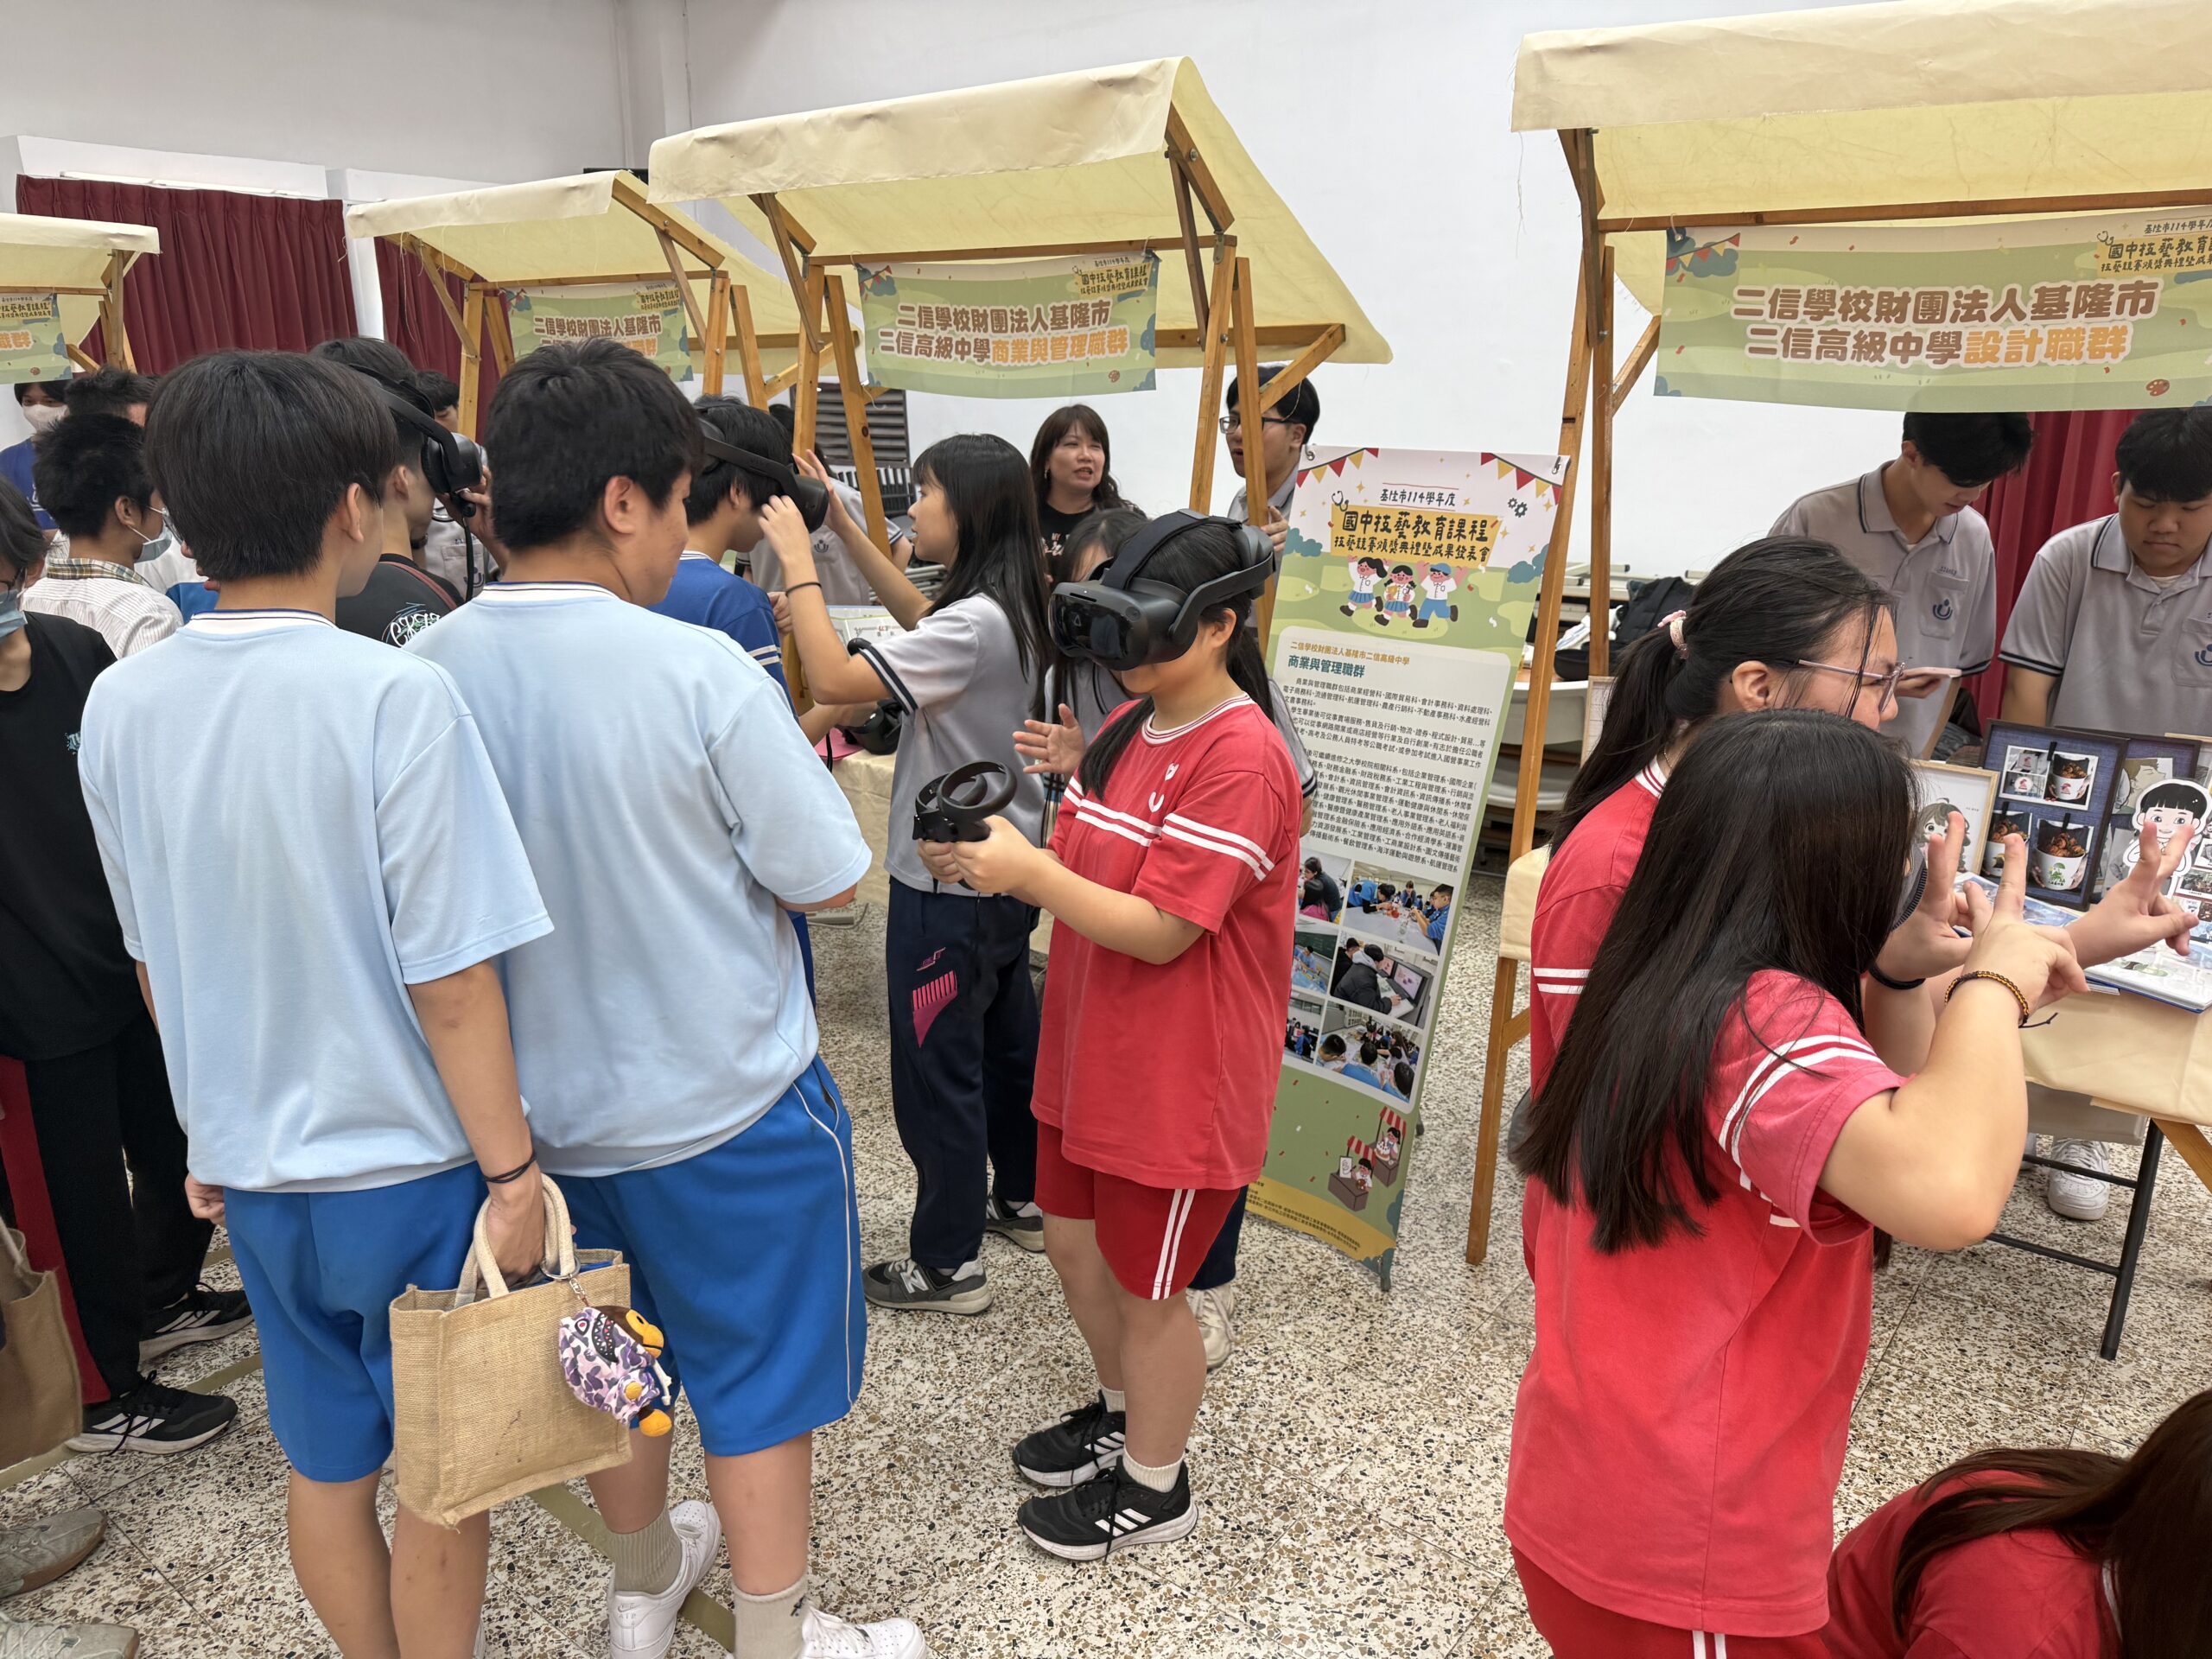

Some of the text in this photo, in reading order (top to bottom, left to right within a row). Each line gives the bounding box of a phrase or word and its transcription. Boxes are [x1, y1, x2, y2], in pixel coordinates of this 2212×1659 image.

[897, 299, 1111, 334] 二信學校財團法人基隆市
[1732, 279, 2160, 325] 二信學校財團法人基隆市
[534, 315, 662, 338] 二信學校財團法人基隆市
[879, 328, 1128, 364] 二信高級中學商業與管理職群
[1747, 325, 2129, 365] 二信高級中學設計職群
[1342, 510, 1489, 543] 國中技藝教育課程
[1334, 534, 1491, 563] 技藝競賽頒獎典禮暨成果發表會
[1287, 655, 1365, 678] 商業與管理職群
[1290, 641, 1410, 664] 二信學校財團法人基隆市二信高級中學
